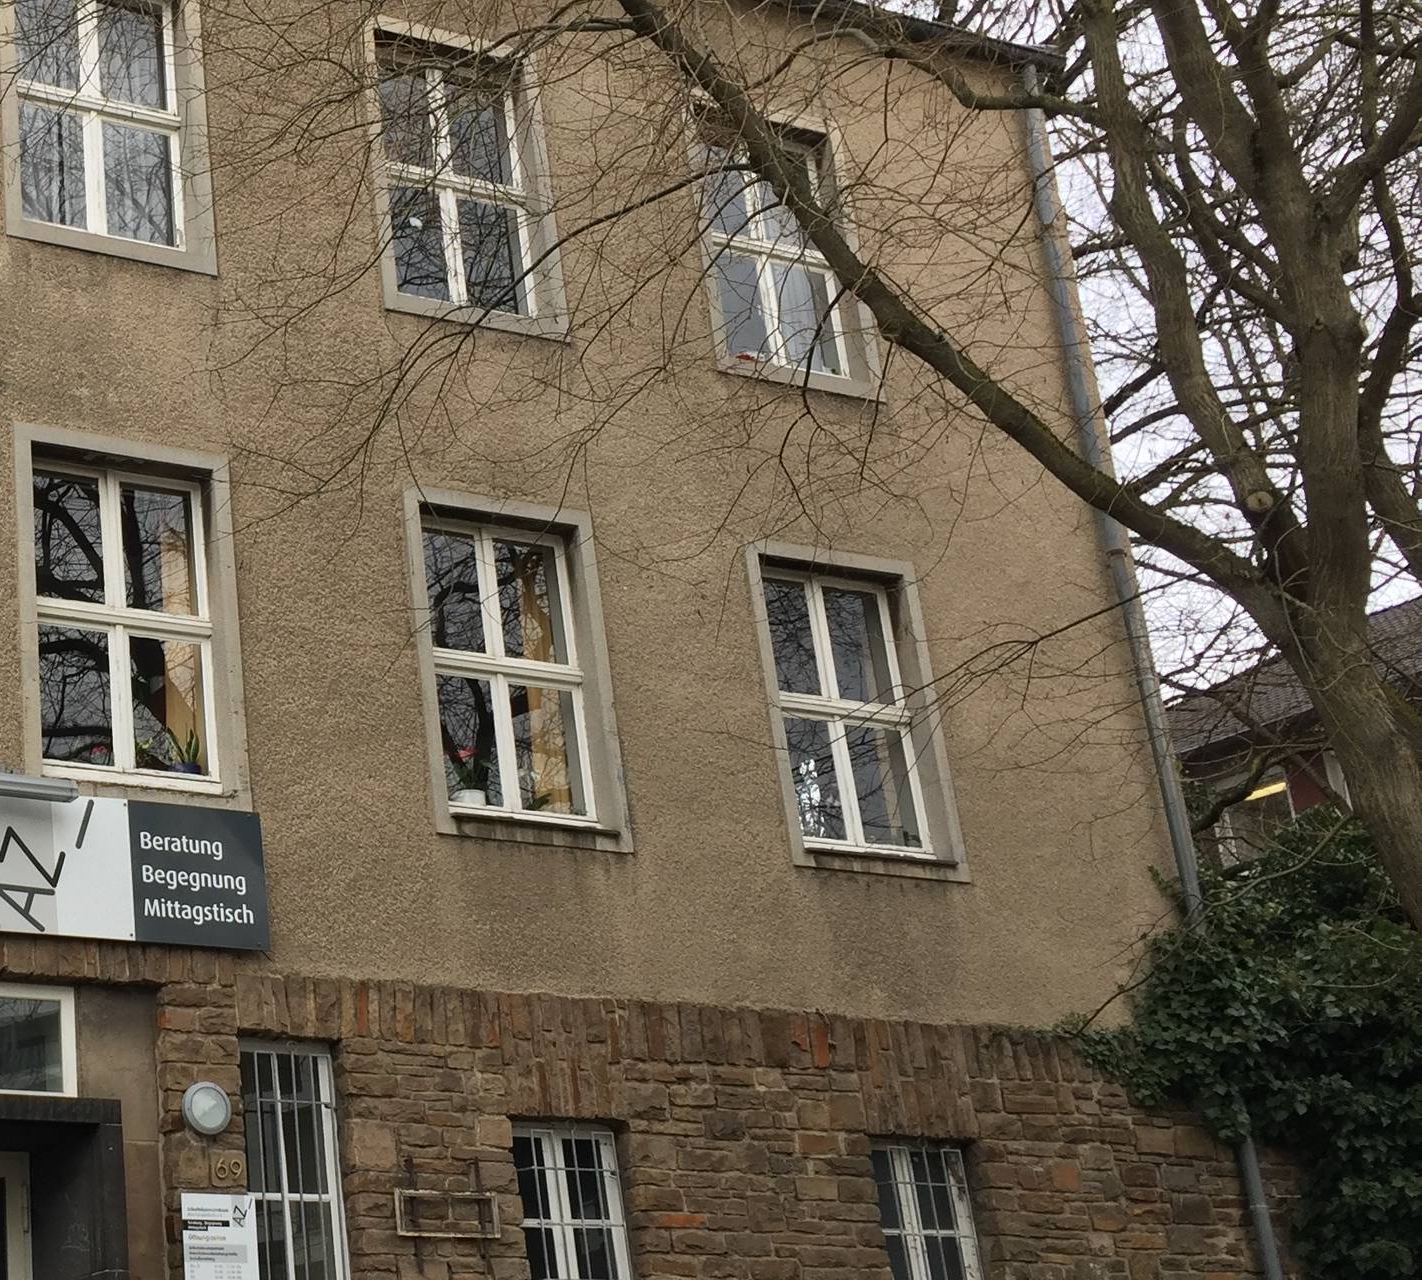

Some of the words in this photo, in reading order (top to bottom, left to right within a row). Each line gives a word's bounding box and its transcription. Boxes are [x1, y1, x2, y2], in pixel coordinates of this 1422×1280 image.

[139, 831, 223, 861] Beratung
[141, 864, 246, 895] Begegnung
[143, 897, 255, 925] Mittagstisch
[215, 1157, 243, 1179] 69
